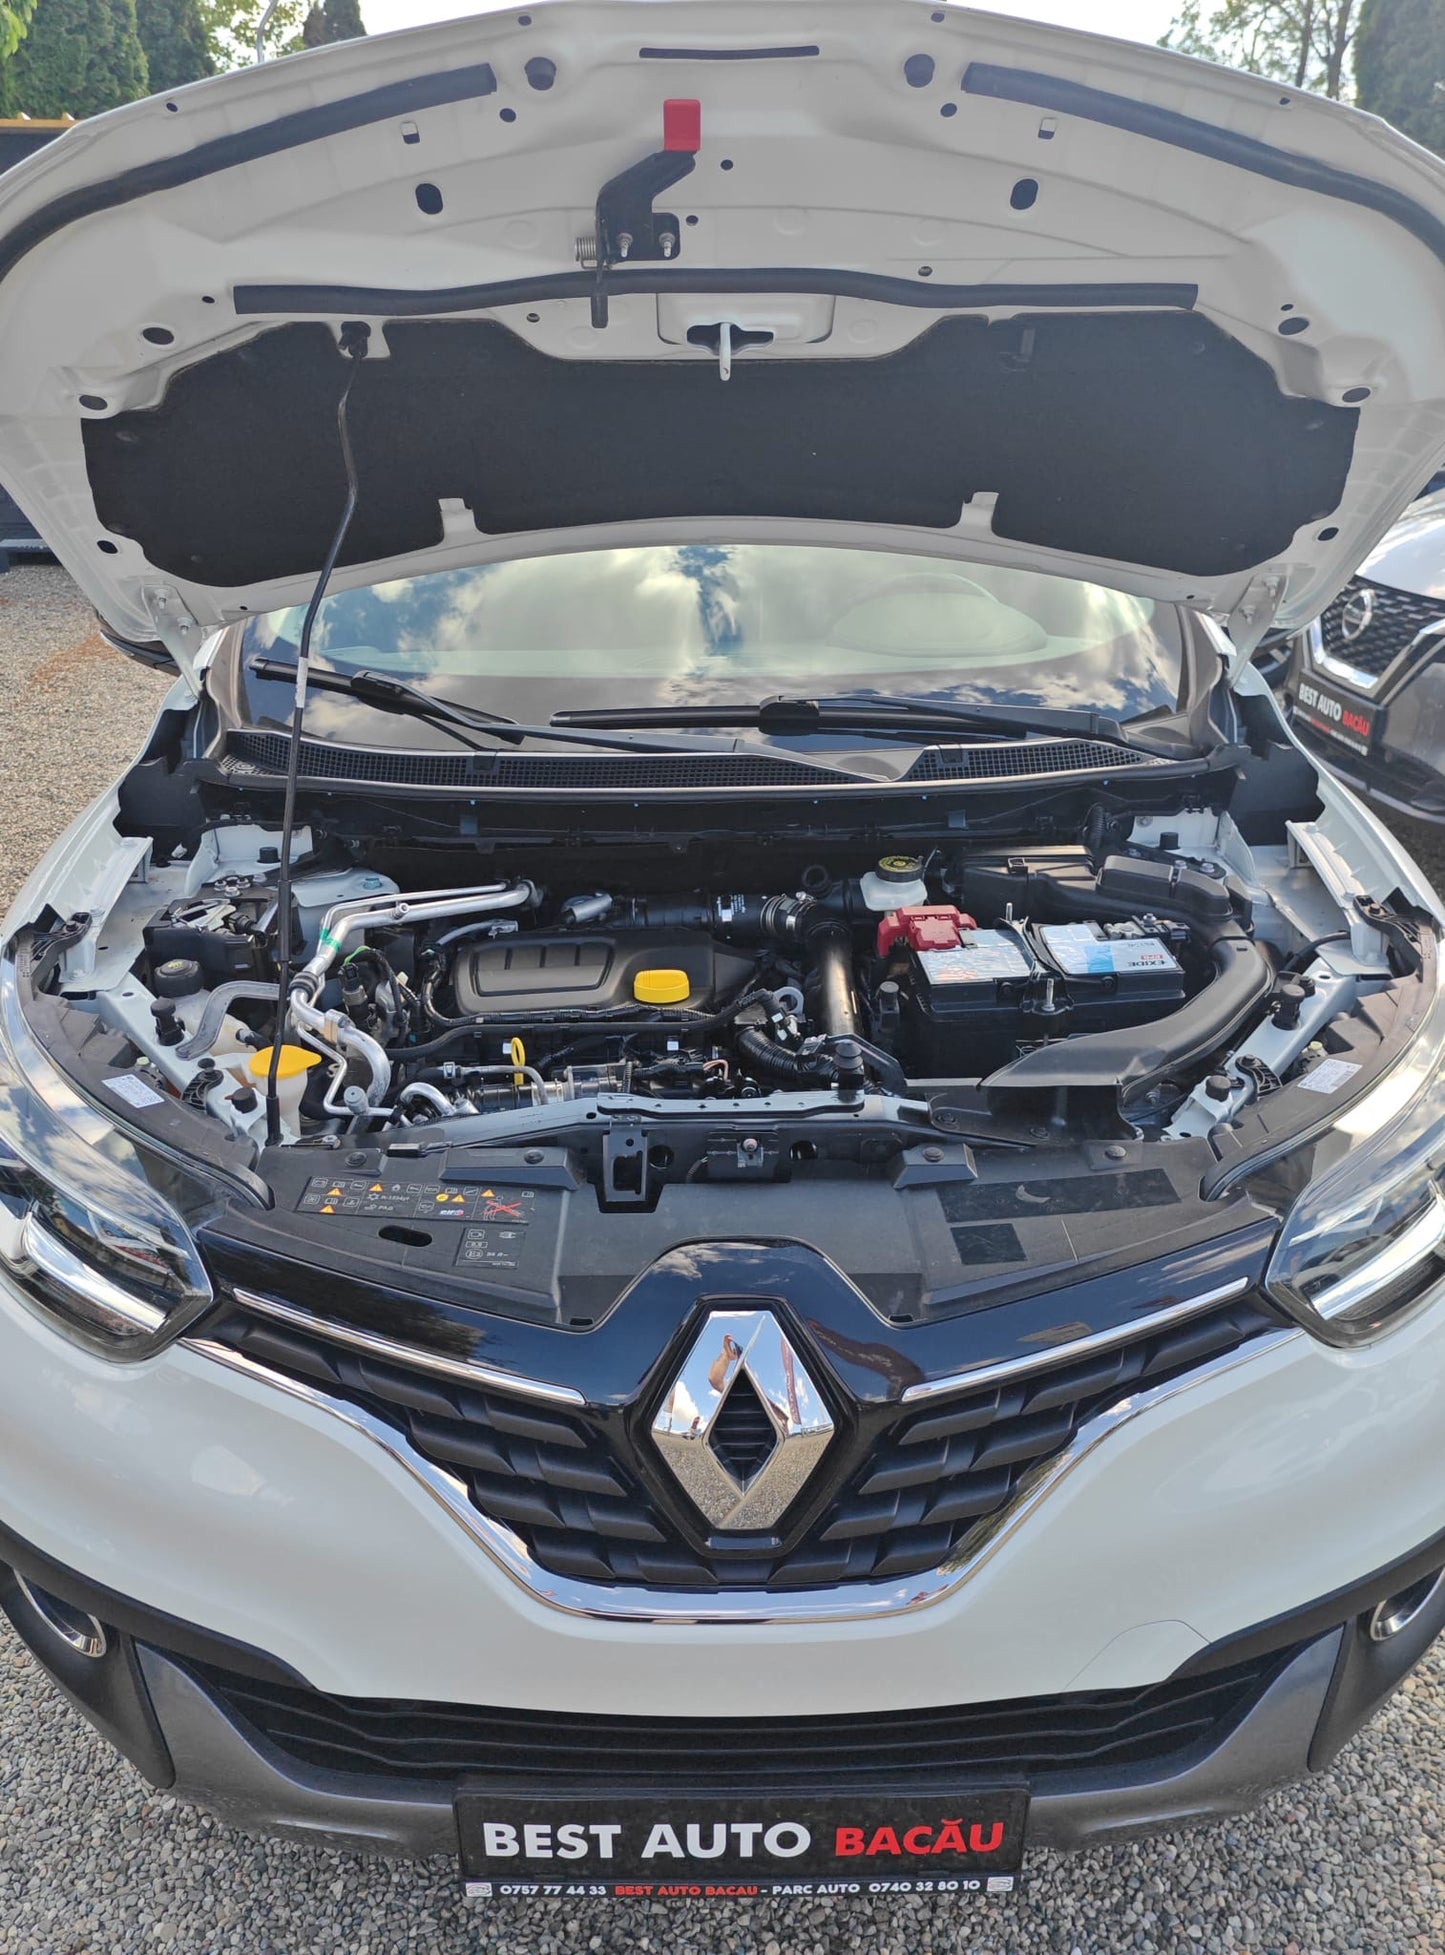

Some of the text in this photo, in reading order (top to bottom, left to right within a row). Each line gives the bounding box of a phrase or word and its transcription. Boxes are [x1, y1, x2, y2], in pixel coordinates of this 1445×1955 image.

[1299, 683, 1318, 707] BEST
[1317, 694, 1342, 721] AUTO
[483, 1818, 1004, 1859] BEST AUTO BACĂU
[500, 1885, 538, 1895] 0757
[543, 1885, 562, 1895] 77
[566, 1885, 586, 1895] 44
[589, 1885, 606, 1895] 33
[615, 1885, 653, 1896] BEST
[658, 1885, 702, 1896] AUTO
[705, 1885, 758, 1896] BACAU
[772, 1884, 812, 1895] PARC
[817, 1883, 860, 1894] AUTO
[868, 1882, 911, 1893] 0740
[915, 1881, 933, 1891] 32
[938, 1881, 959, 1891] 80
[962, 1880, 981, 1890] 10
